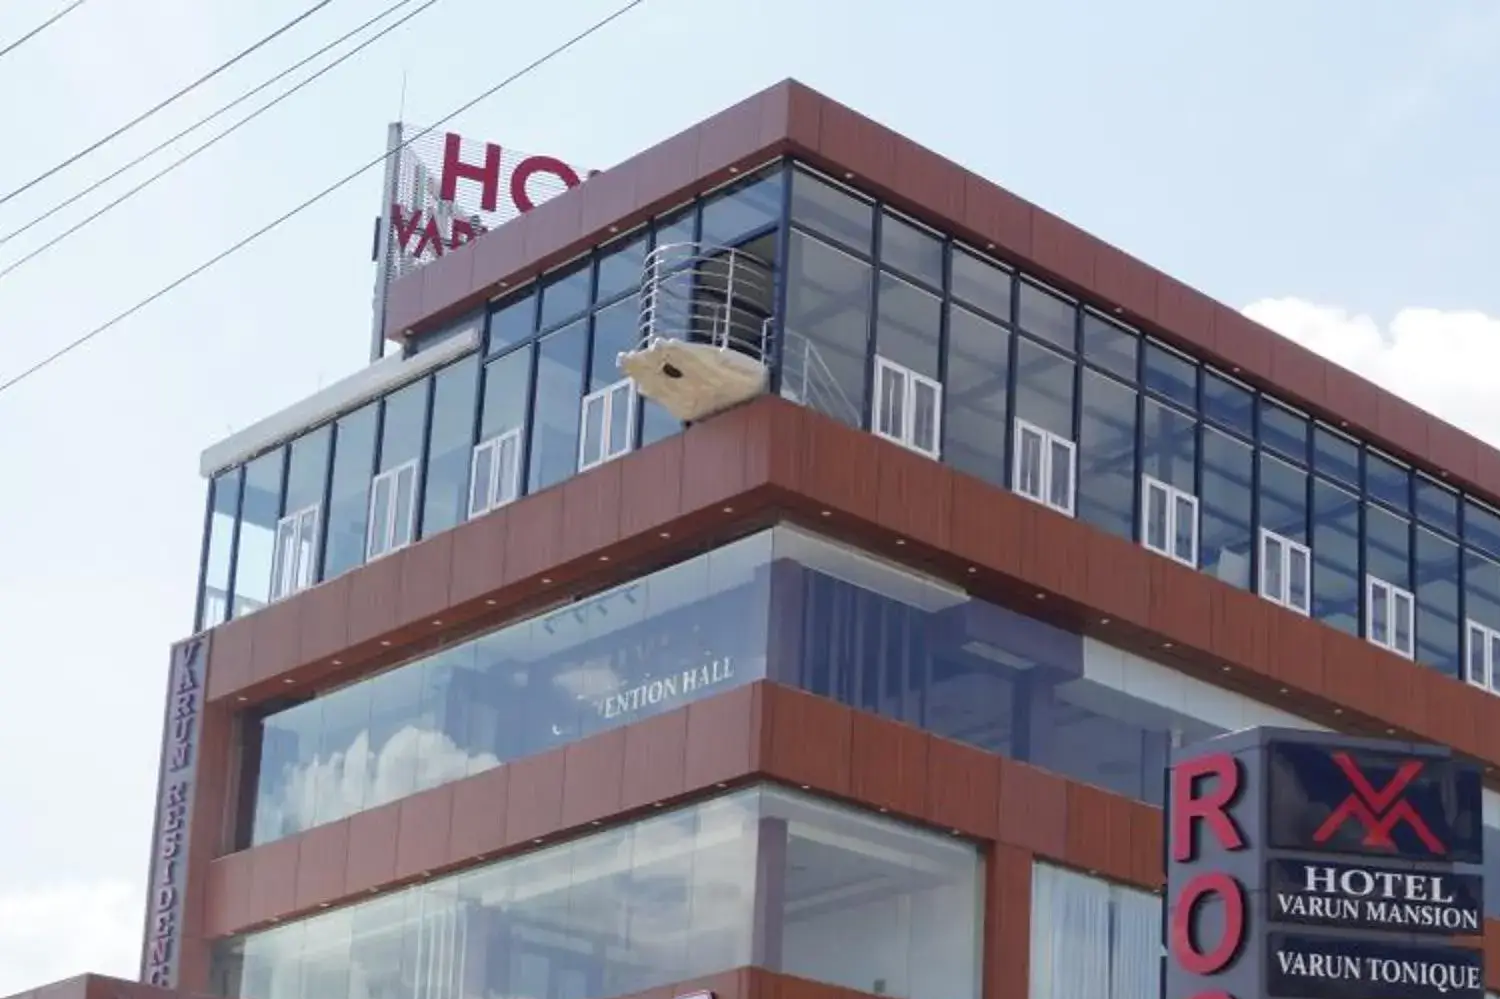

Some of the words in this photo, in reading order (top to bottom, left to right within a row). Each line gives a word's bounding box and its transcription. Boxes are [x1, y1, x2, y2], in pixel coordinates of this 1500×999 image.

[441, 132, 603, 213] HO
[682, 656, 736, 693] HALL
[1304, 865, 1453, 903] HOTEL
[1277, 893, 1360, 919] VARUN
[1366, 901, 1479, 929] MANSION
[1277, 950, 1361, 980] VARUN
[1366, 956, 1481, 992] TONIQUE
